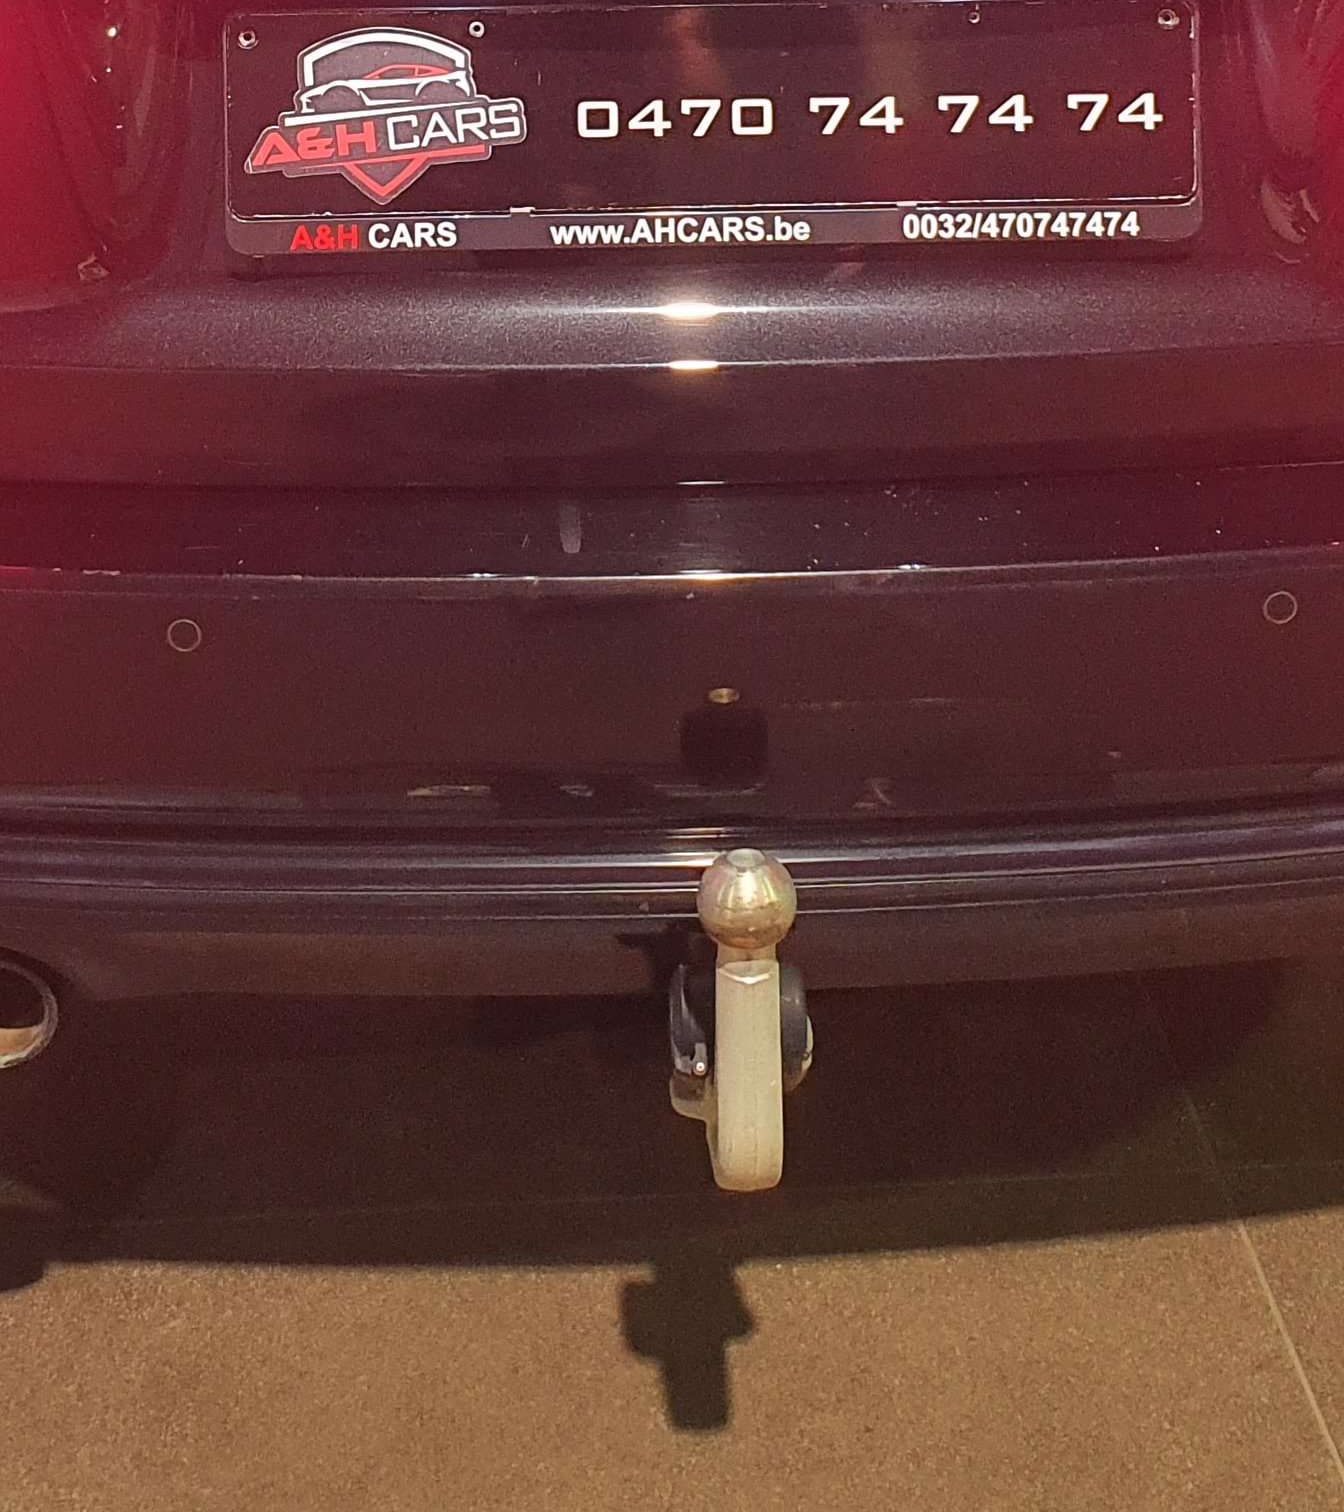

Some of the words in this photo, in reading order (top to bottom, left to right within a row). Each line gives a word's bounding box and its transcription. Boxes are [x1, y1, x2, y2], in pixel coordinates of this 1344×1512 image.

[577, 98, 773, 138] 0470
[809, 96, 904, 135] 74
[937, 94, 1034, 133] 74
[1067, 92, 1164, 131] 74
[253, 121, 377, 166] A&H
[386, 103, 521, 151] CARS
[290, 224, 359, 251] A&H
[367, 222, 457, 249] CARS
[550, 216, 811, 244] www.AHCARS.be
[902, 211, 1140, 239] 0032/470747474
